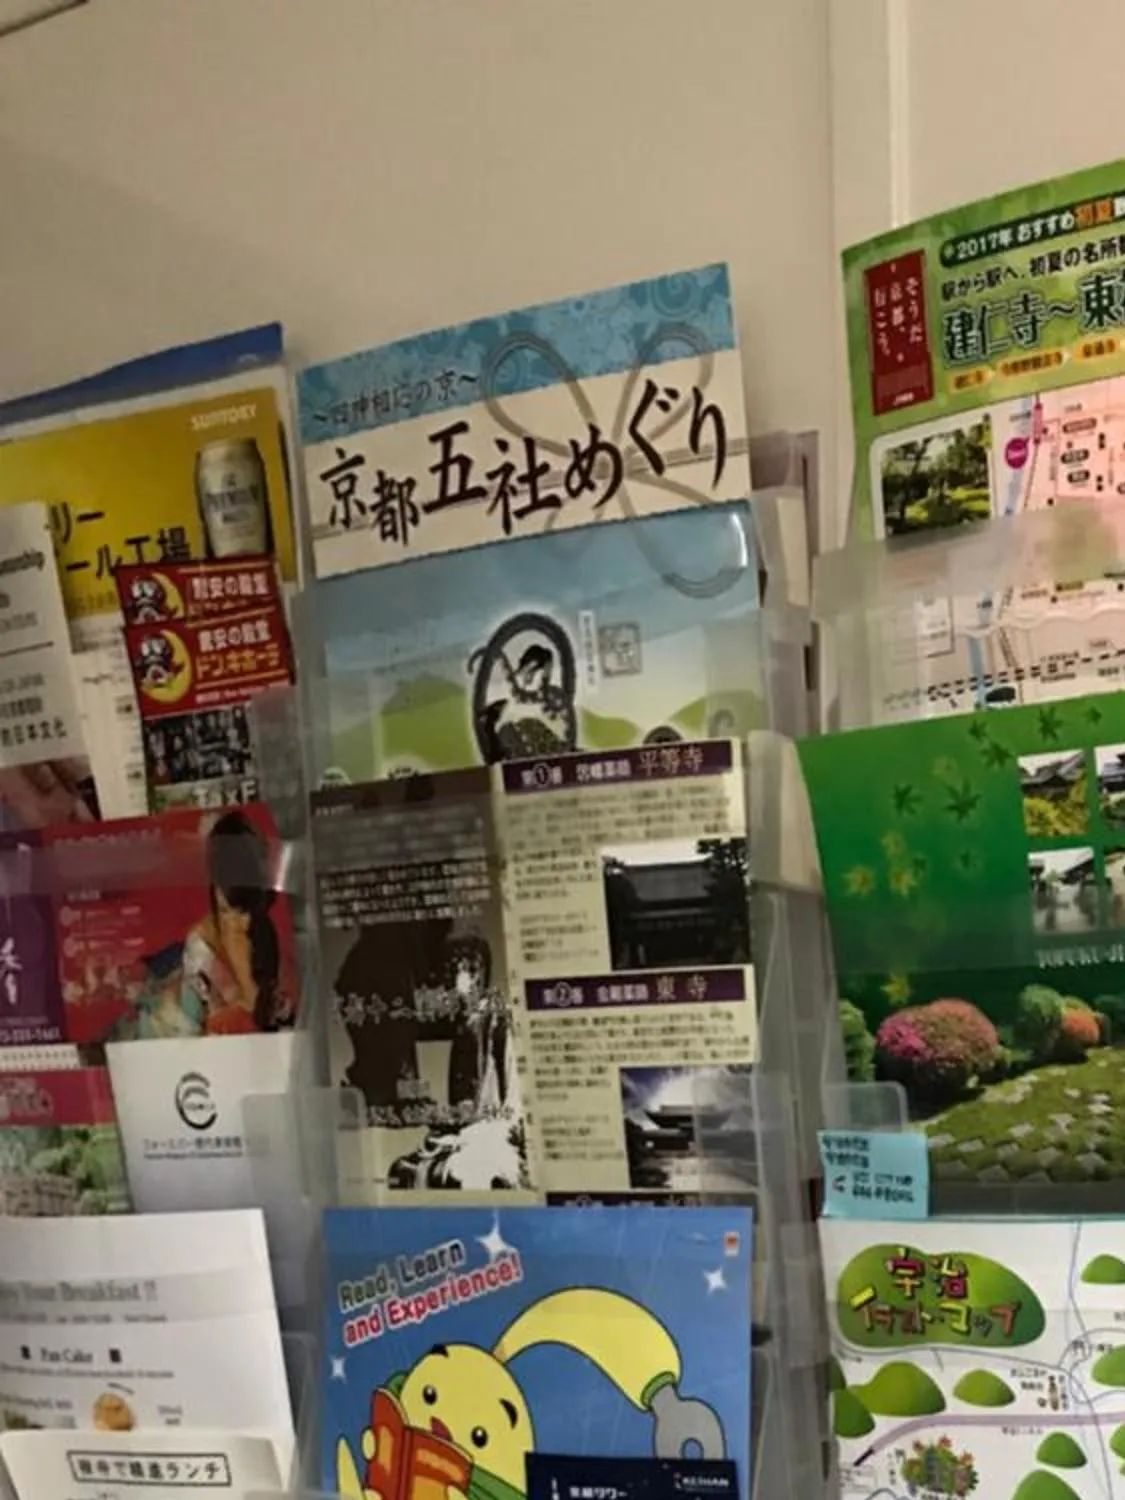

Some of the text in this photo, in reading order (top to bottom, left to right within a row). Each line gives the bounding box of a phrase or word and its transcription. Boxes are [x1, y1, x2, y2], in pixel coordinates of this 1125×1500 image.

[319, 378, 729, 546] 京都五社めぐり
[336, 1237, 468, 1314] Read, Learn
[341, 1250, 524, 1347] and Experience!
